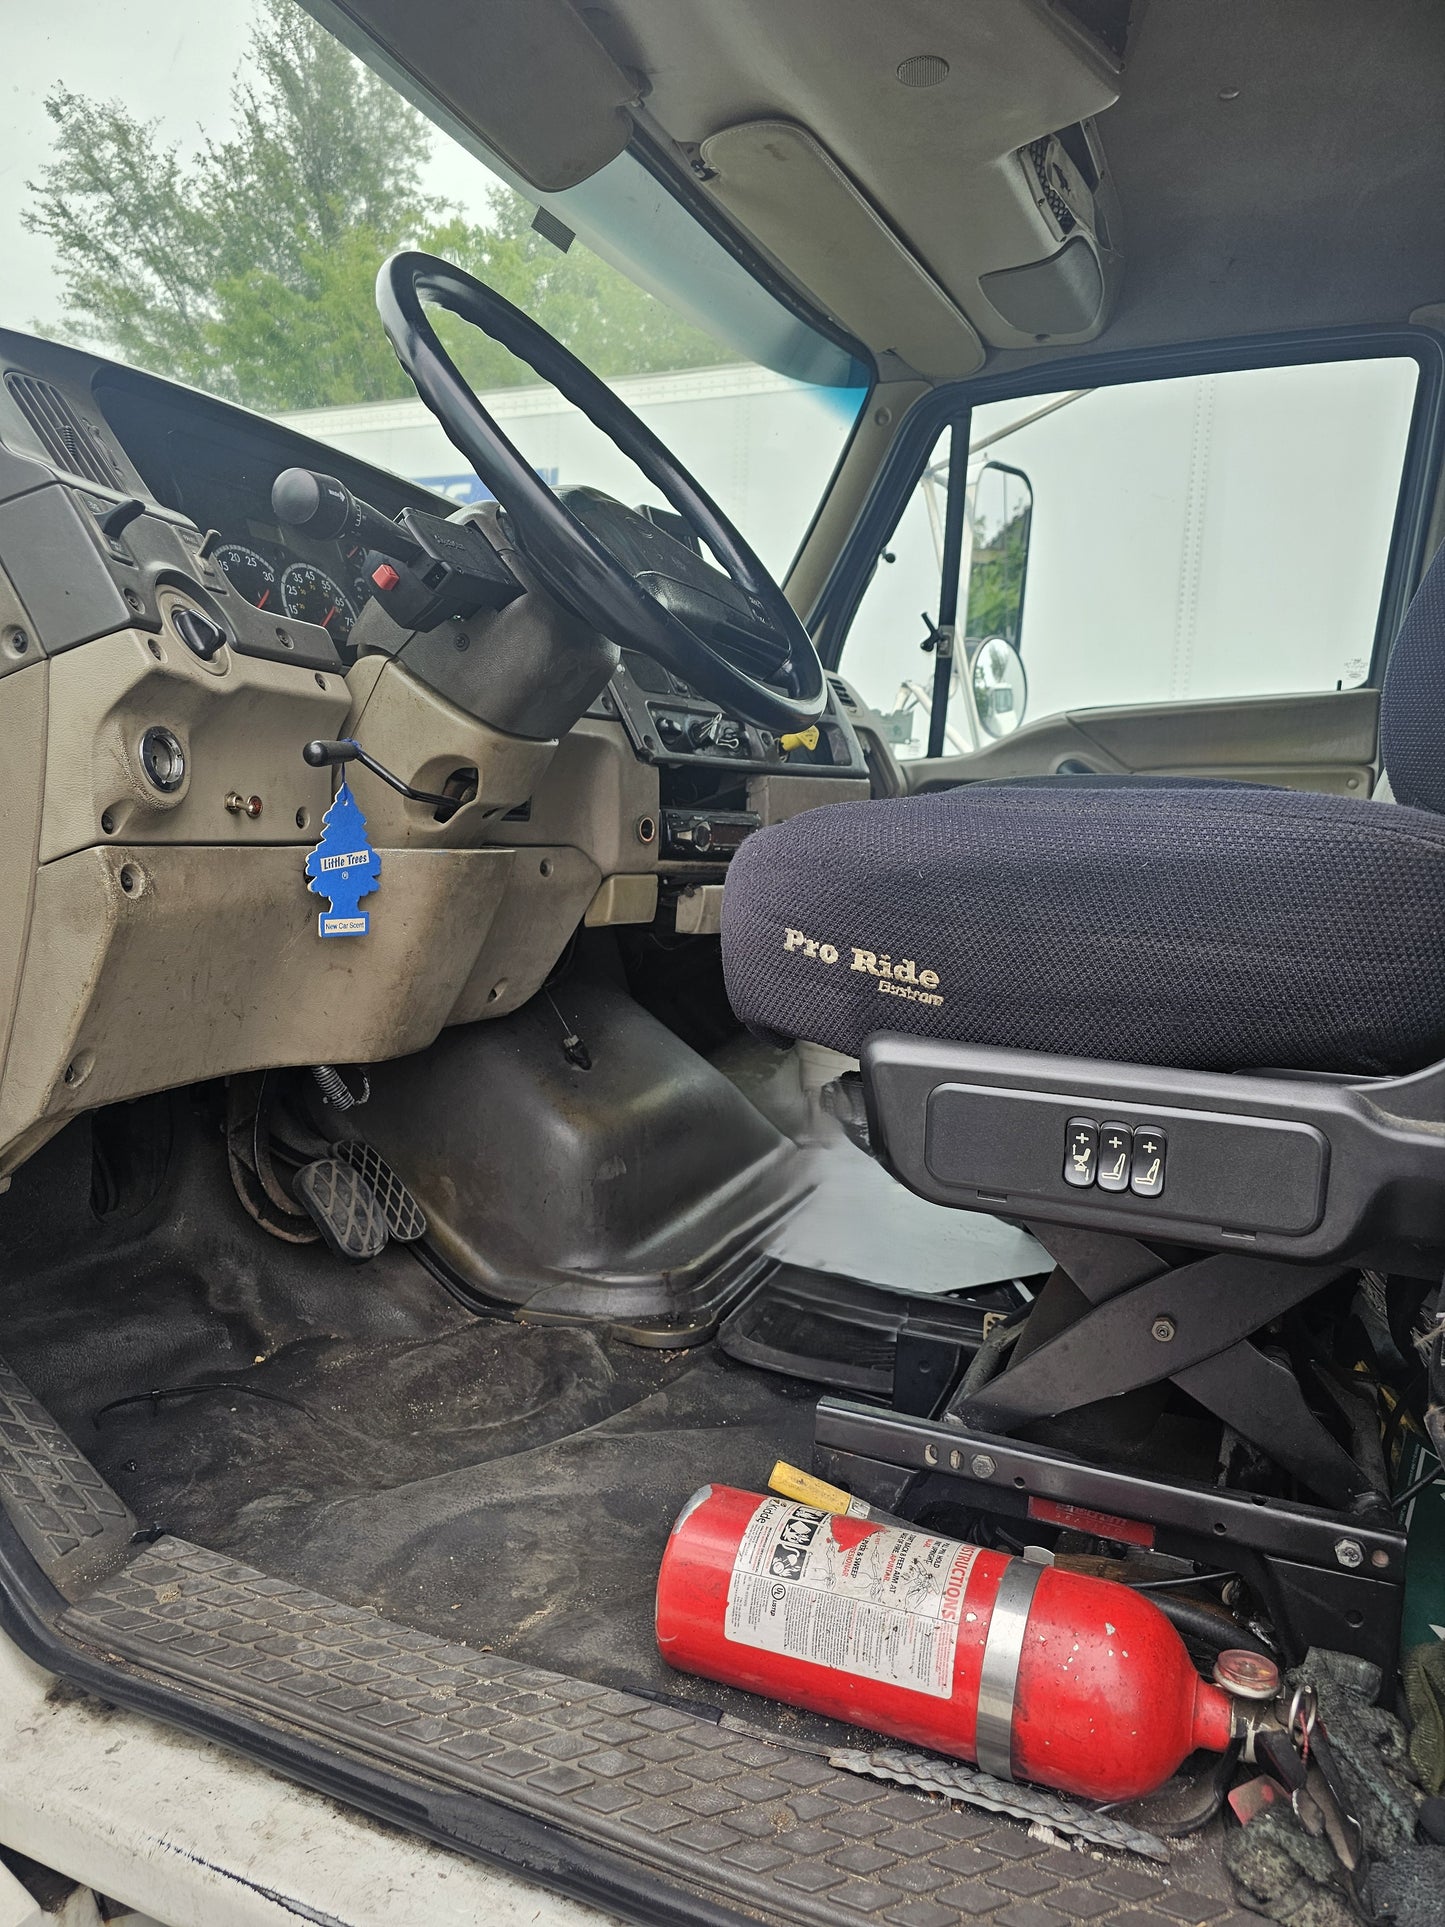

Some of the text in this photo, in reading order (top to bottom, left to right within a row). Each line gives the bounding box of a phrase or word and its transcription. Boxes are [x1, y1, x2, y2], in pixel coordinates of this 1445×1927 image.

[228, 552, 241, 563] 20
[245, 555, 257, 567] 25
[262, 571, 275, 582] 30
[291, 572, 304, 583] 35
[305, 570, 316, 581] 45
[286, 584, 298, 595] 25
[321, 580, 332, 591] 55
[335, 597, 345, 607] 65
[289, 604, 298, 615] 15
[323, 853, 367, 870] Little Trees
[325, 921, 364, 930] New Car Scent
[783, 927, 940, 990] Pro Ride
[901, 1542, 912, 1553] BACK
[851, 1556, 861, 1579] SWEEP
[891, 1570, 901, 1584] AIM
[889, 1584, 897, 1594] AT
